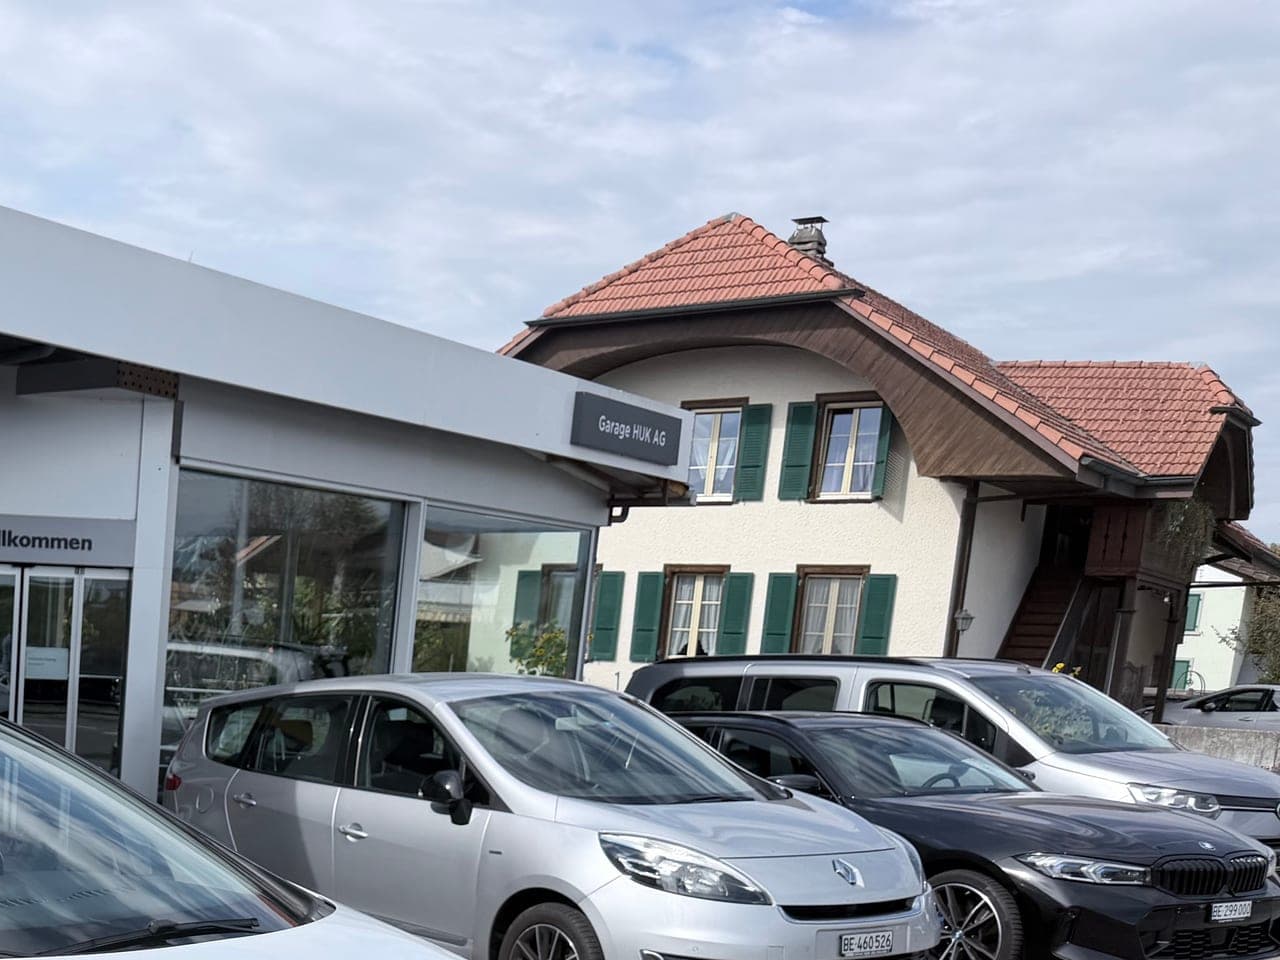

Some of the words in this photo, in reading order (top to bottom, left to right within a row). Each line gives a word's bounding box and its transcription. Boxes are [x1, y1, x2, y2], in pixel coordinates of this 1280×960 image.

[598, 415, 631, 440] Garage
[632, 423, 652, 443] HUK
[652, 429, 666, 447] AG
